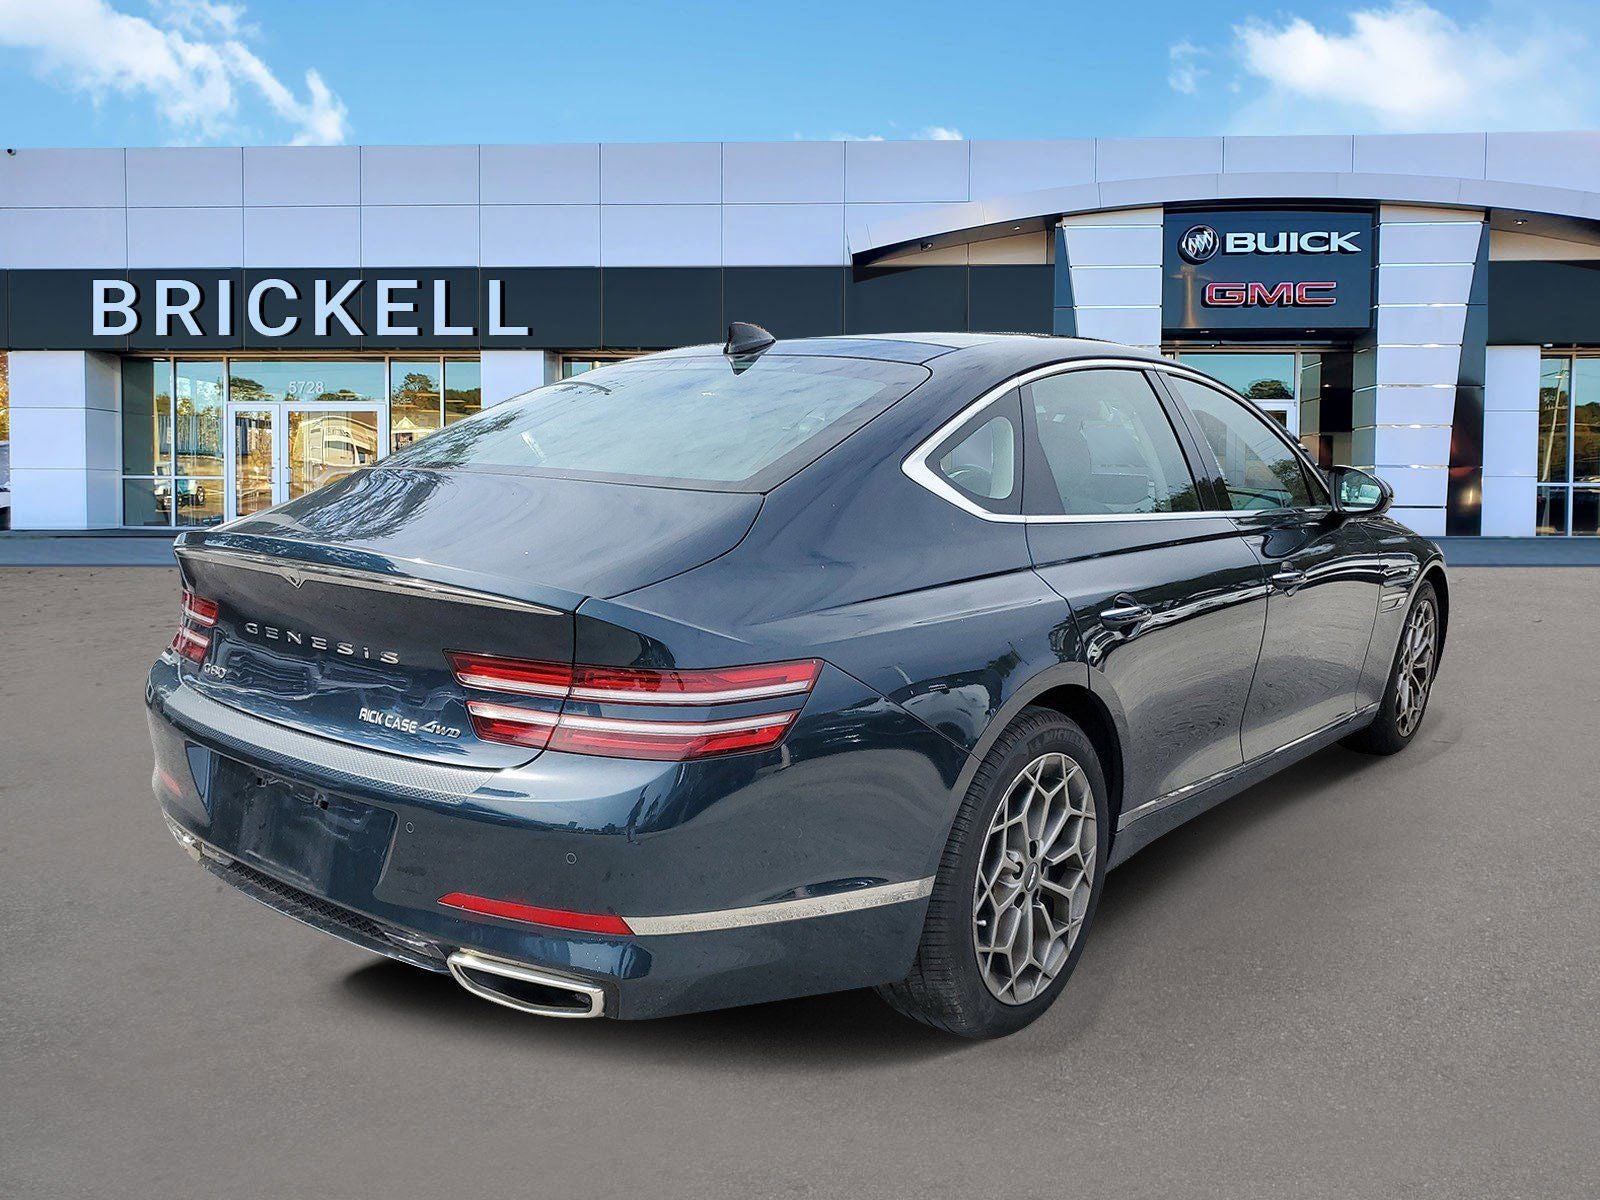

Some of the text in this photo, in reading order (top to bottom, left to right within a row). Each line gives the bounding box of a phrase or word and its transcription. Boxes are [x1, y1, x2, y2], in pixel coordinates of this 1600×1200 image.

[1225, 231, 1362, 253] BUICK
[1205, 282, 1337, 305] GMC
[92, 278, 531, 337] BRICKELL
[288, 381, 325, 394] 5728
[245, 622, 400, 665] GENESIS
[358, 707, 418, 734] RICK CASE
